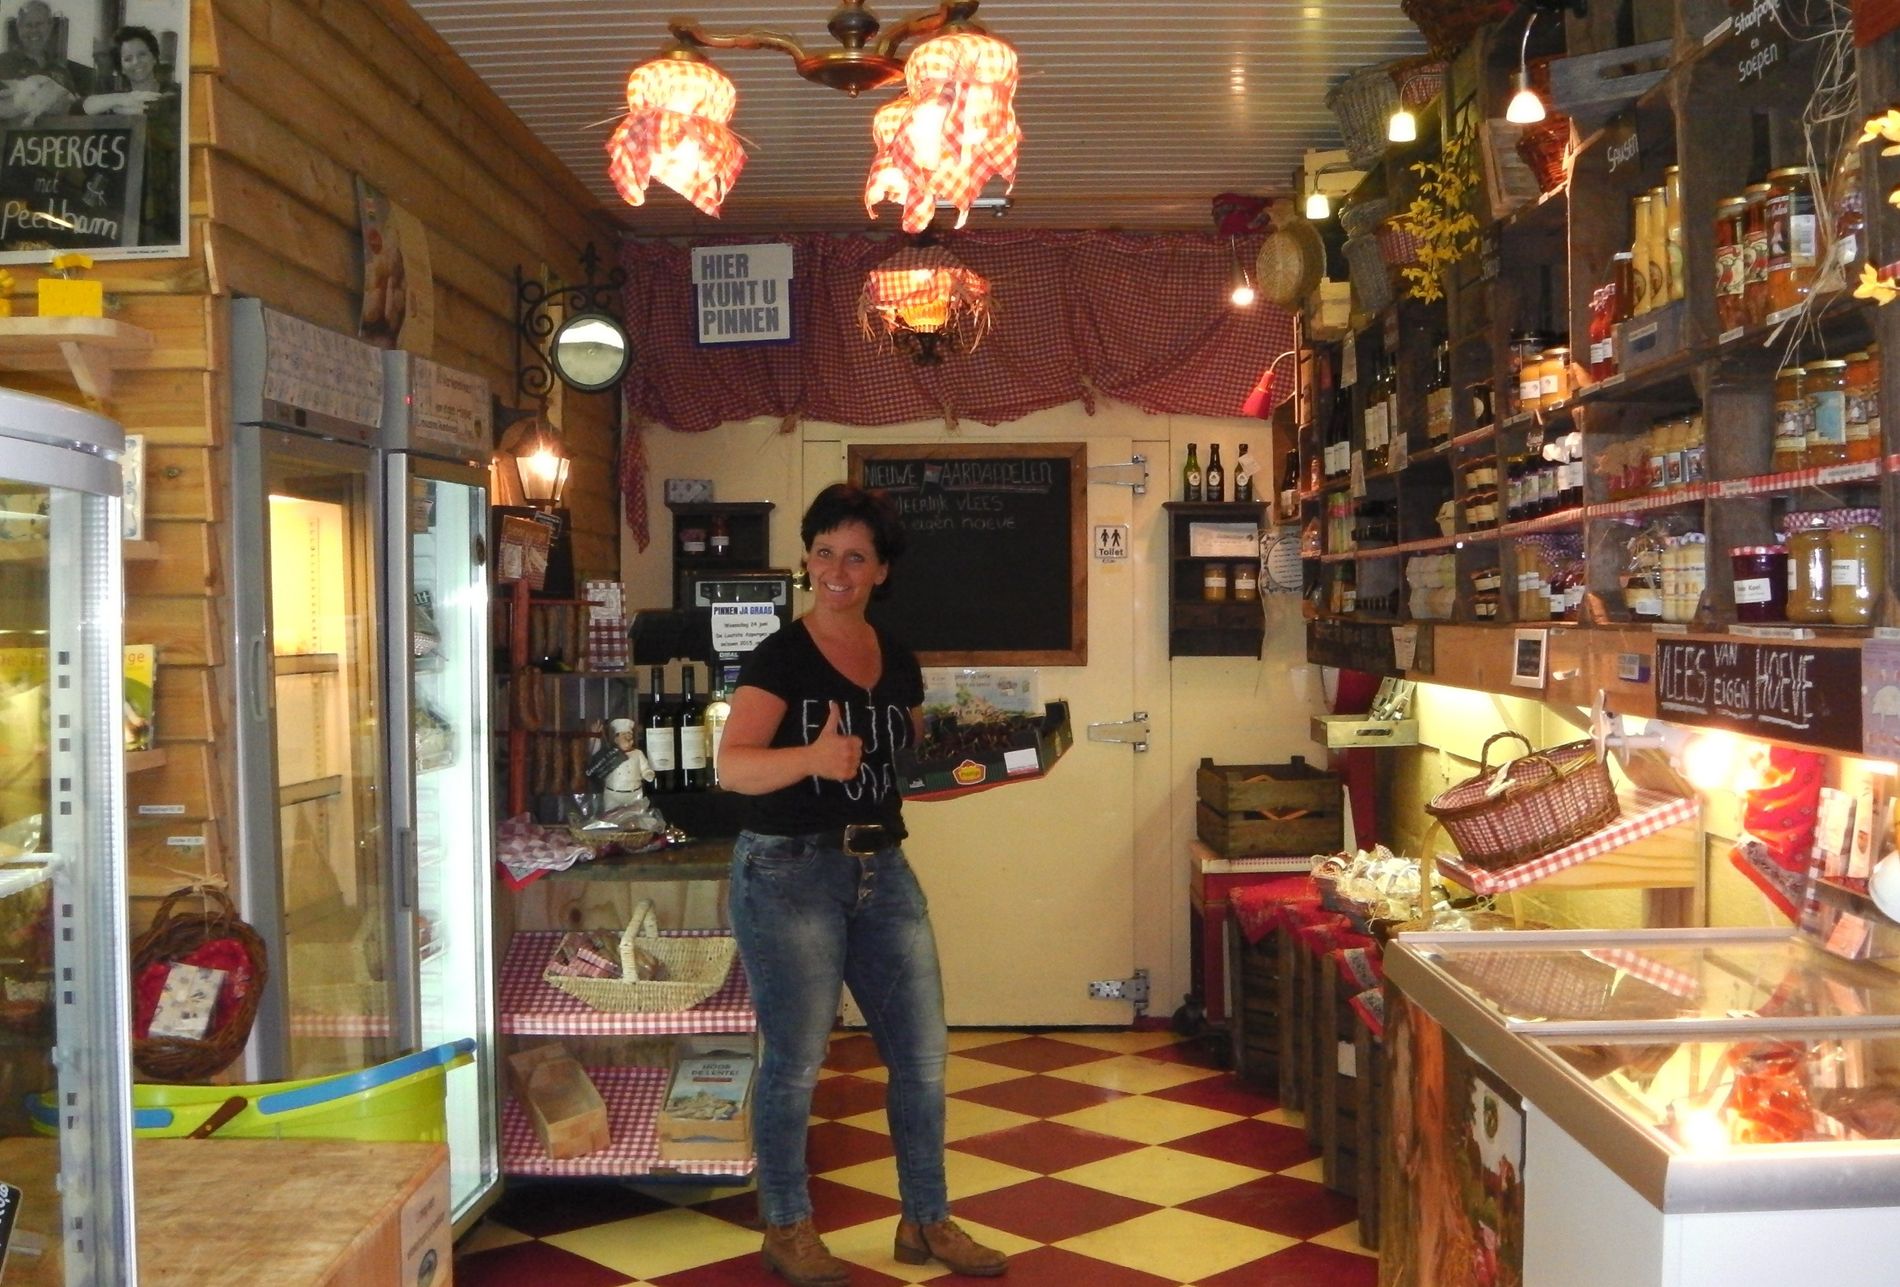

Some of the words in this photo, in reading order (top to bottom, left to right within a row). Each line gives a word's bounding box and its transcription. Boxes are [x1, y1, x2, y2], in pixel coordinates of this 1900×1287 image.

[9, 135, 126, 171] ASPERGES
[701, 253, 748, 280] HIER
[702, 280, 758, 308] KUNT
[762, 279, 777, 305] U
[703, 306, 779, 335] PINNEN
[864, 464, 917, 487] NIEUWE
[1099, 548, 1124, 556] Toilet
[713, 606, 738, 615] PINNEN
[739, 606, 749, 615] JA
[750, 605, 773, 615] GRAAG
[1656, 643, 1707, 704] VLEES
[1713, 643, 1738, 667] VAN
[1755, 648, 1816, 718] HOEVE
